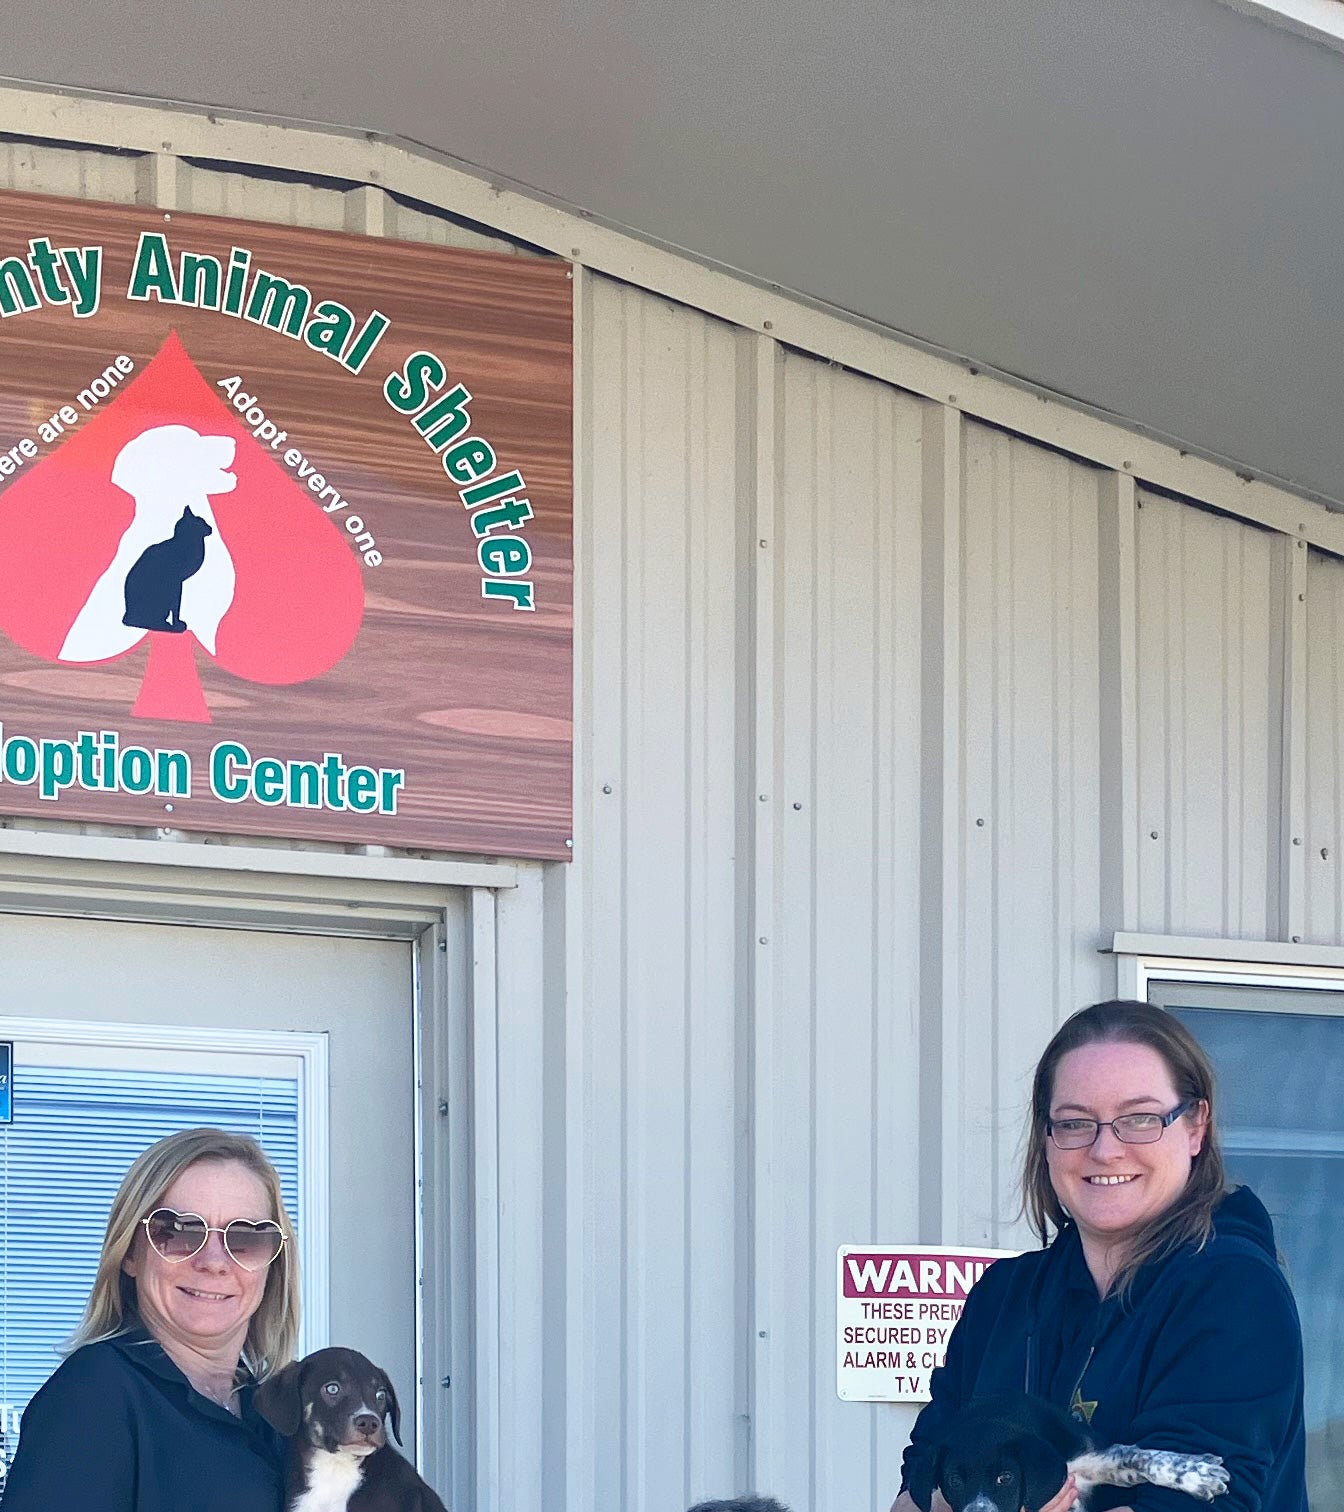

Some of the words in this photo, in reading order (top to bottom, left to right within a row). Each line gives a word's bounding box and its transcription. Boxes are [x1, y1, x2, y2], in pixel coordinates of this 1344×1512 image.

[37, 404, 80, 443] are
[76, 354, 135, 411] none
[127, 232, 391, 375] Animal
[383, 350, 536, 611] Shelter
[216, 374, 290, 450] Adopt
[283, 447, 349, 514] every
[344, 514, 384, 569] one
[209, 740, 405, 816] Center
[846, 1259, 993, 1295] WARNI
[861, 1303, 914, 1320] THESE
[843, 1326, 921, 1344] SECURED
[926, 1328, 948, 1345] BY
[843, 1351, 901, 1368] ALARM
[905, 1351, 917, 1368] &
[895, 1376, 924, 1393] T.V.
